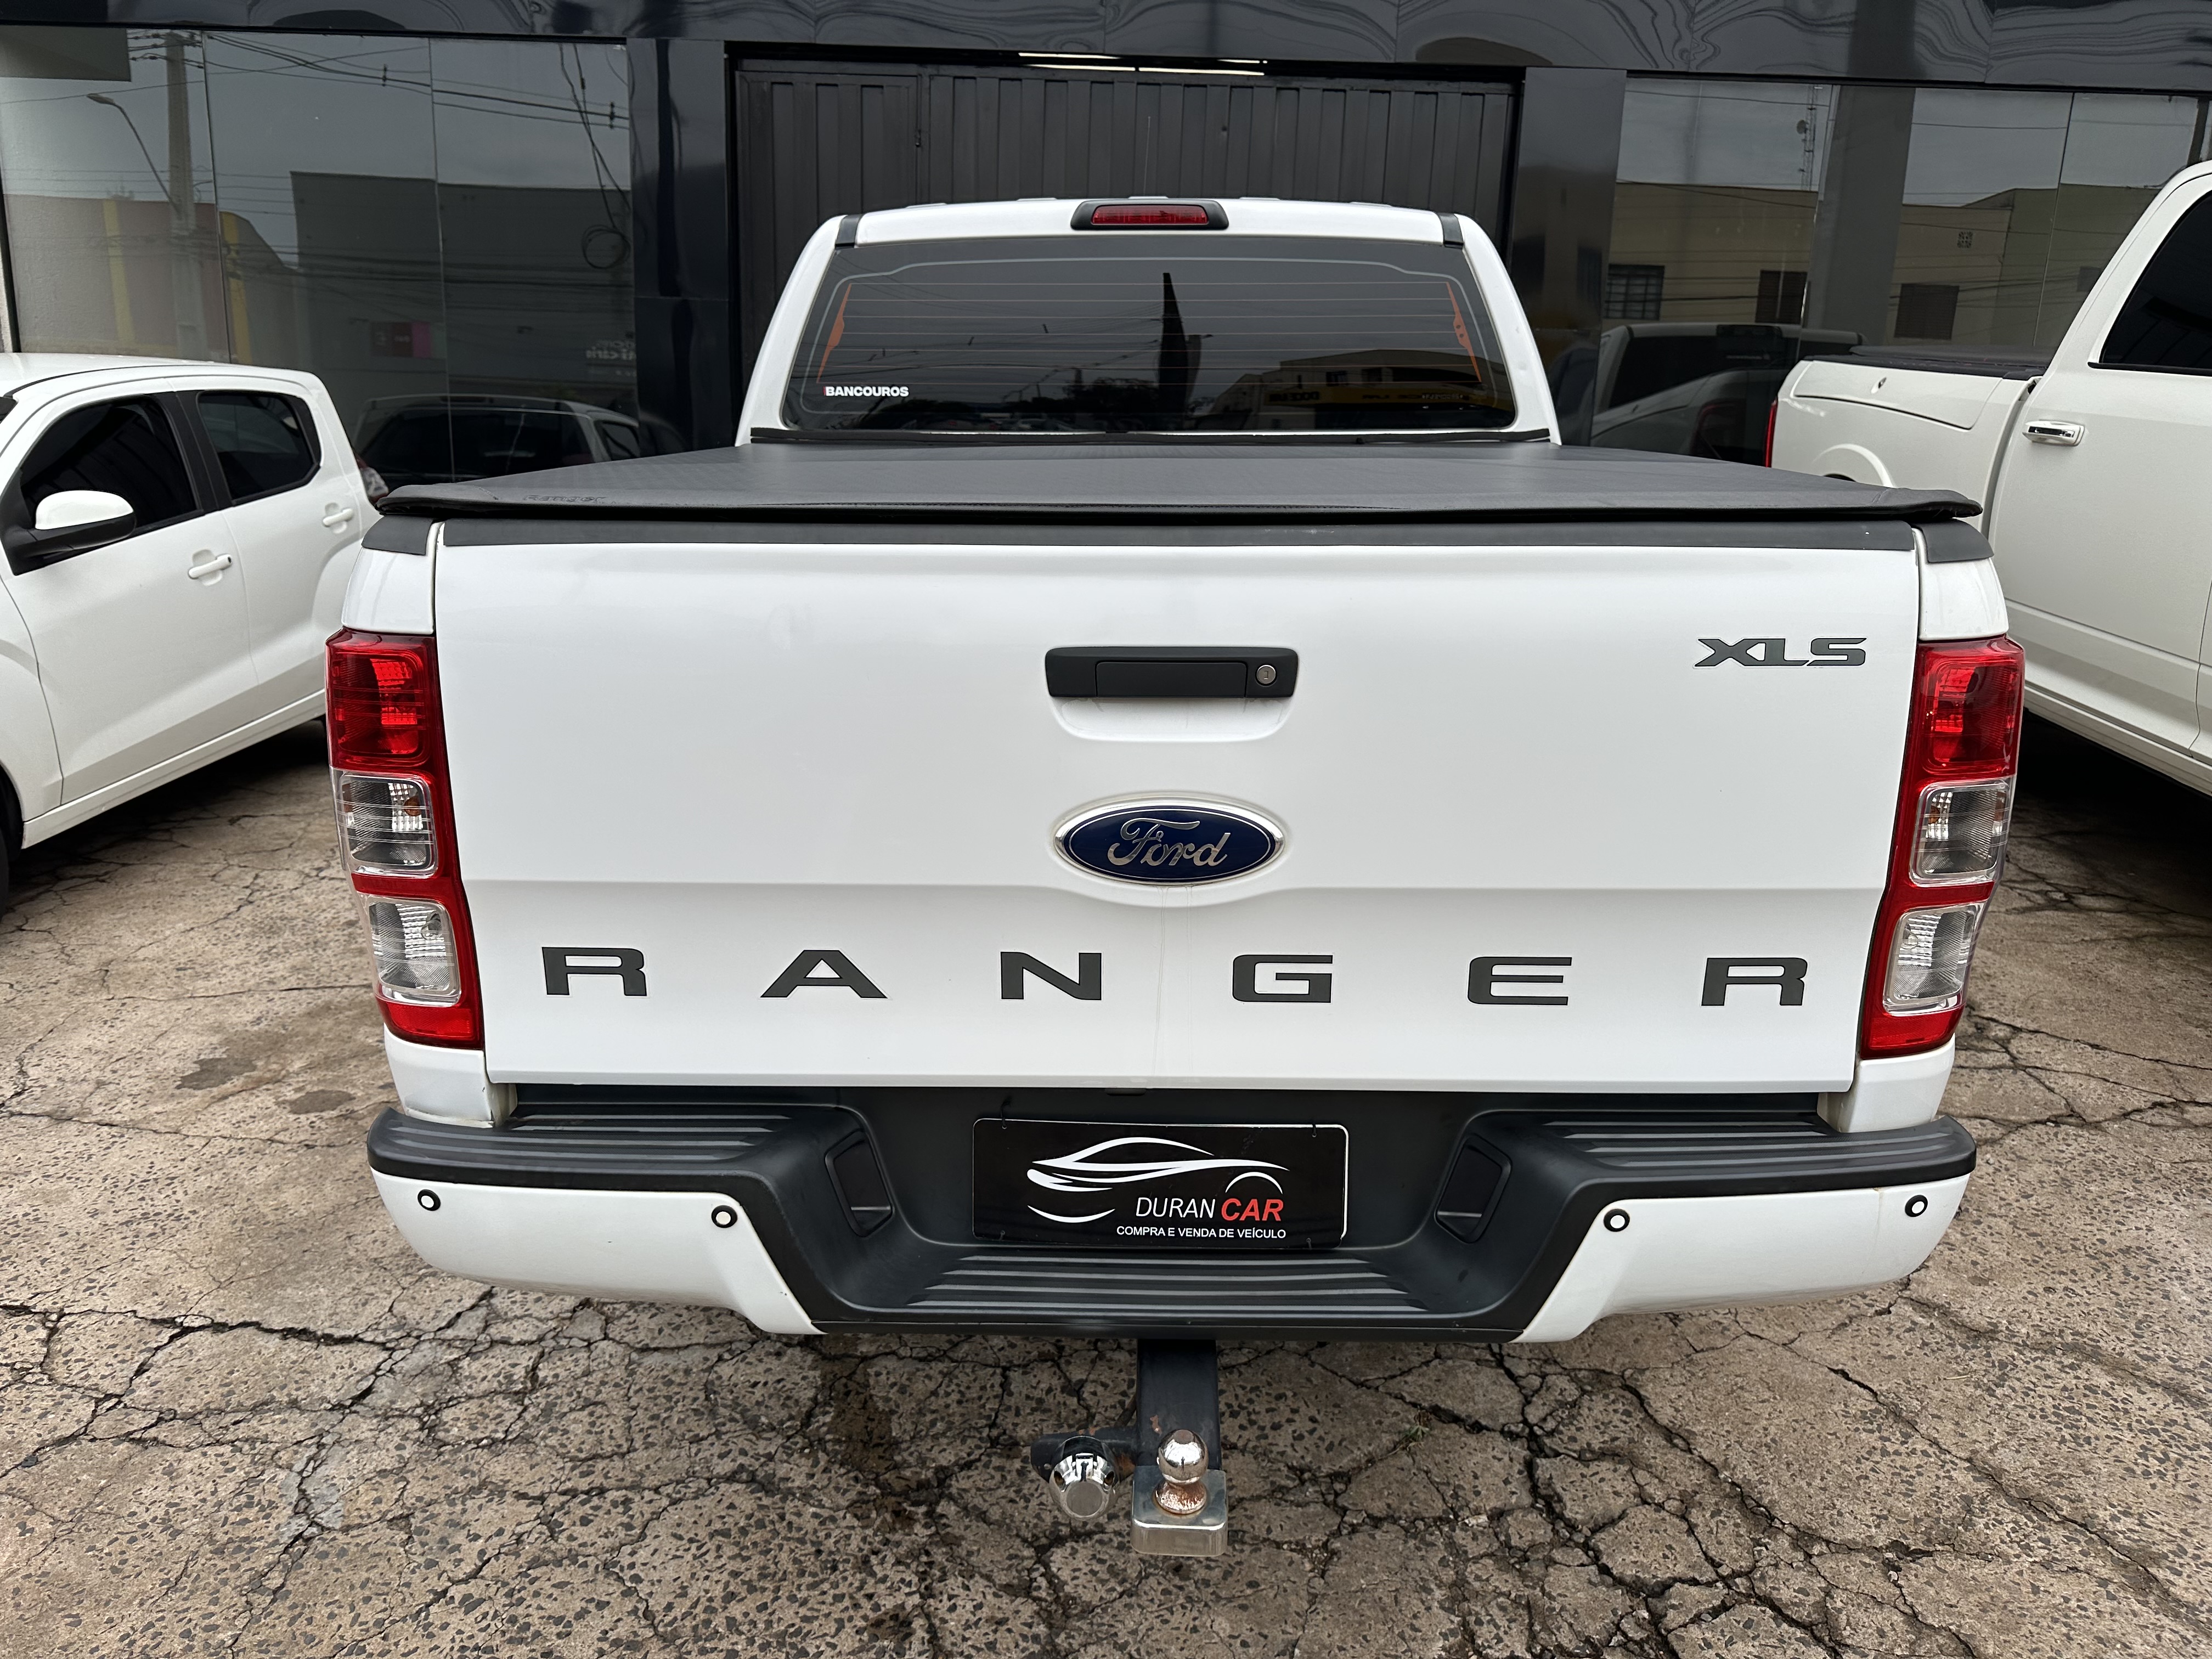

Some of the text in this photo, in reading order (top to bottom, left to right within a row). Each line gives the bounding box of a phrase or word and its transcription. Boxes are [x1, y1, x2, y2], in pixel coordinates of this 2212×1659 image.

[825, 386, 910, 397] BANCOUROS
[522, 494, 606, 504] Ranger
[1695, 637, 1867, 667] XLS
[1107, 817, 1231, 866] Ford
[541, 946, 1808, 1006] RANGER
[1136, 1197, 1284, 1221] DURAN CAR
[1116, 1226, 1286, 1239] COMPRA E VENDA DE VEÍCULO
